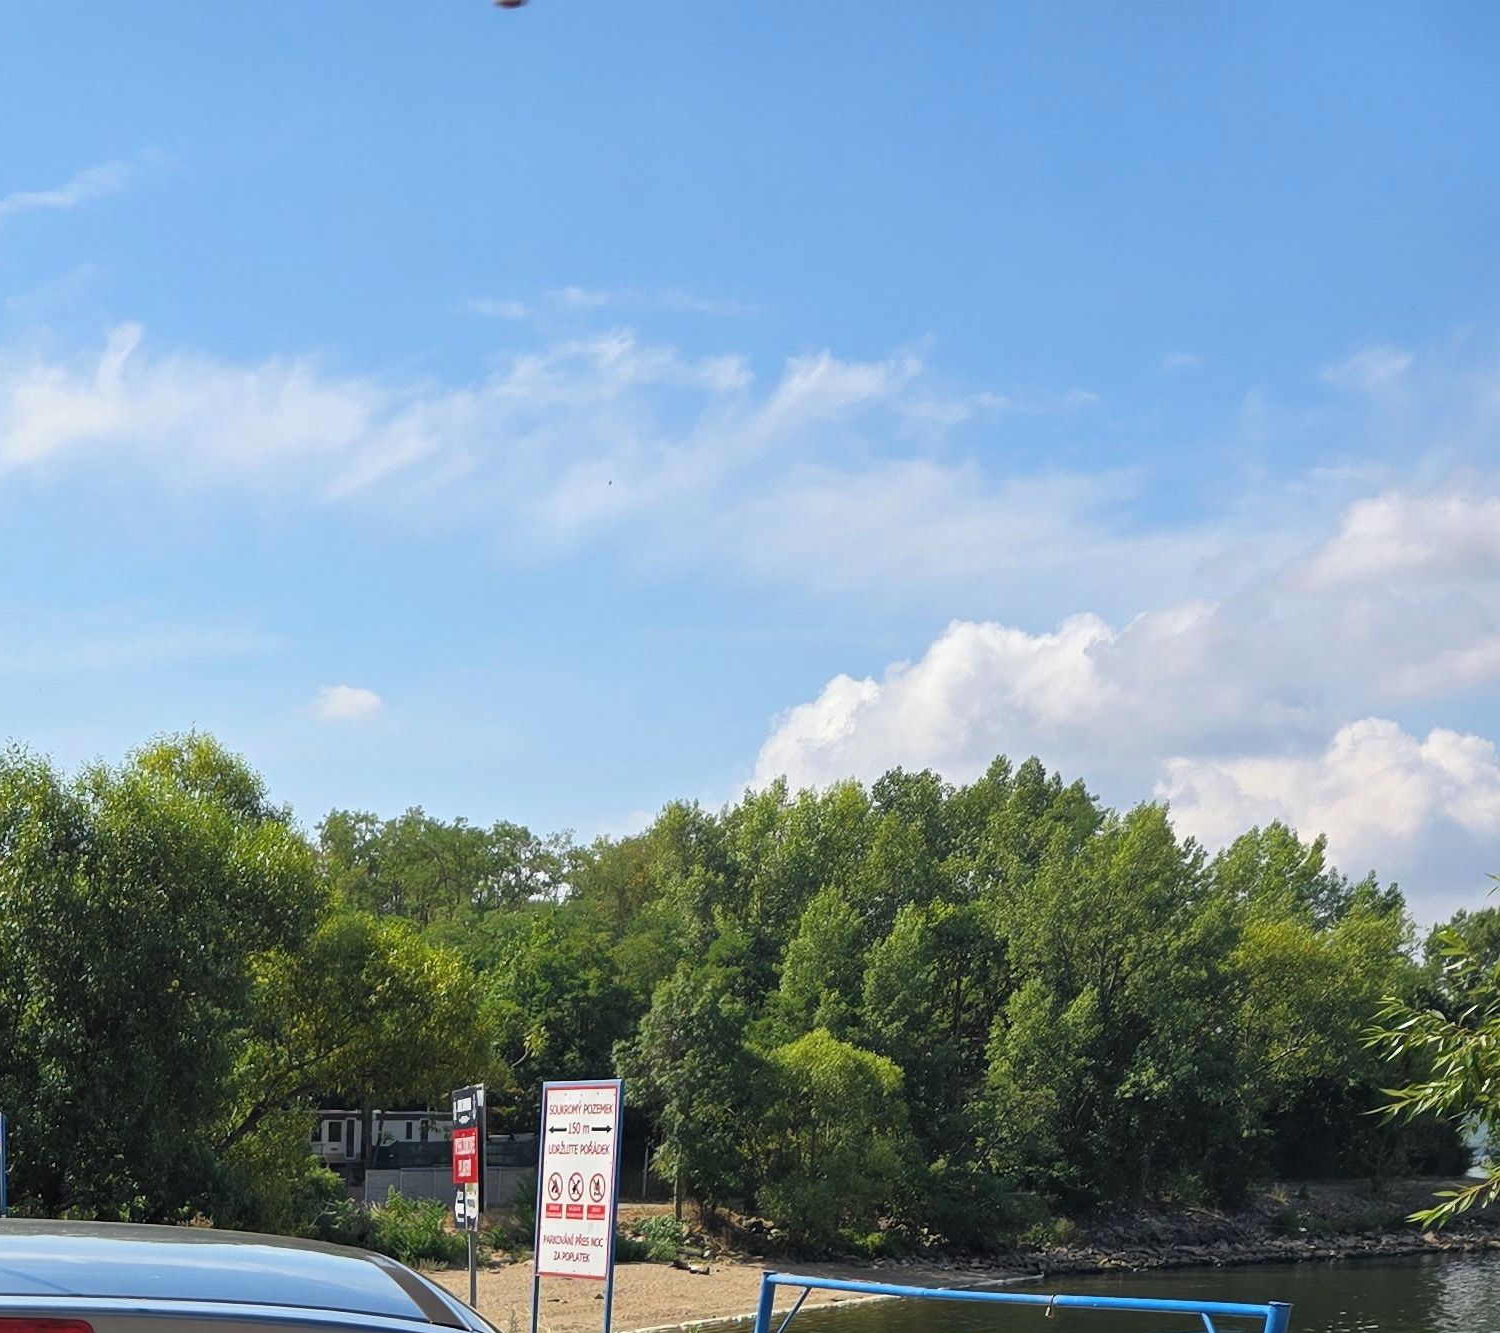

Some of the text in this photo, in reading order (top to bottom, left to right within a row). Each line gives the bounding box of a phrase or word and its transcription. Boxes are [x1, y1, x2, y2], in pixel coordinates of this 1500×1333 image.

[549, 1101, 613, 1115] SOUKROMÝ POZEMEK
[568, 1122, 590, 1134] 150 m
[580, 1140, 611, 1155] POŘÁDEK
[543, 1233, 604, 1247] PARKOVÁNÍ PŘES NOC
[553, 1251, 590, 1262] ZA POPLATEK
